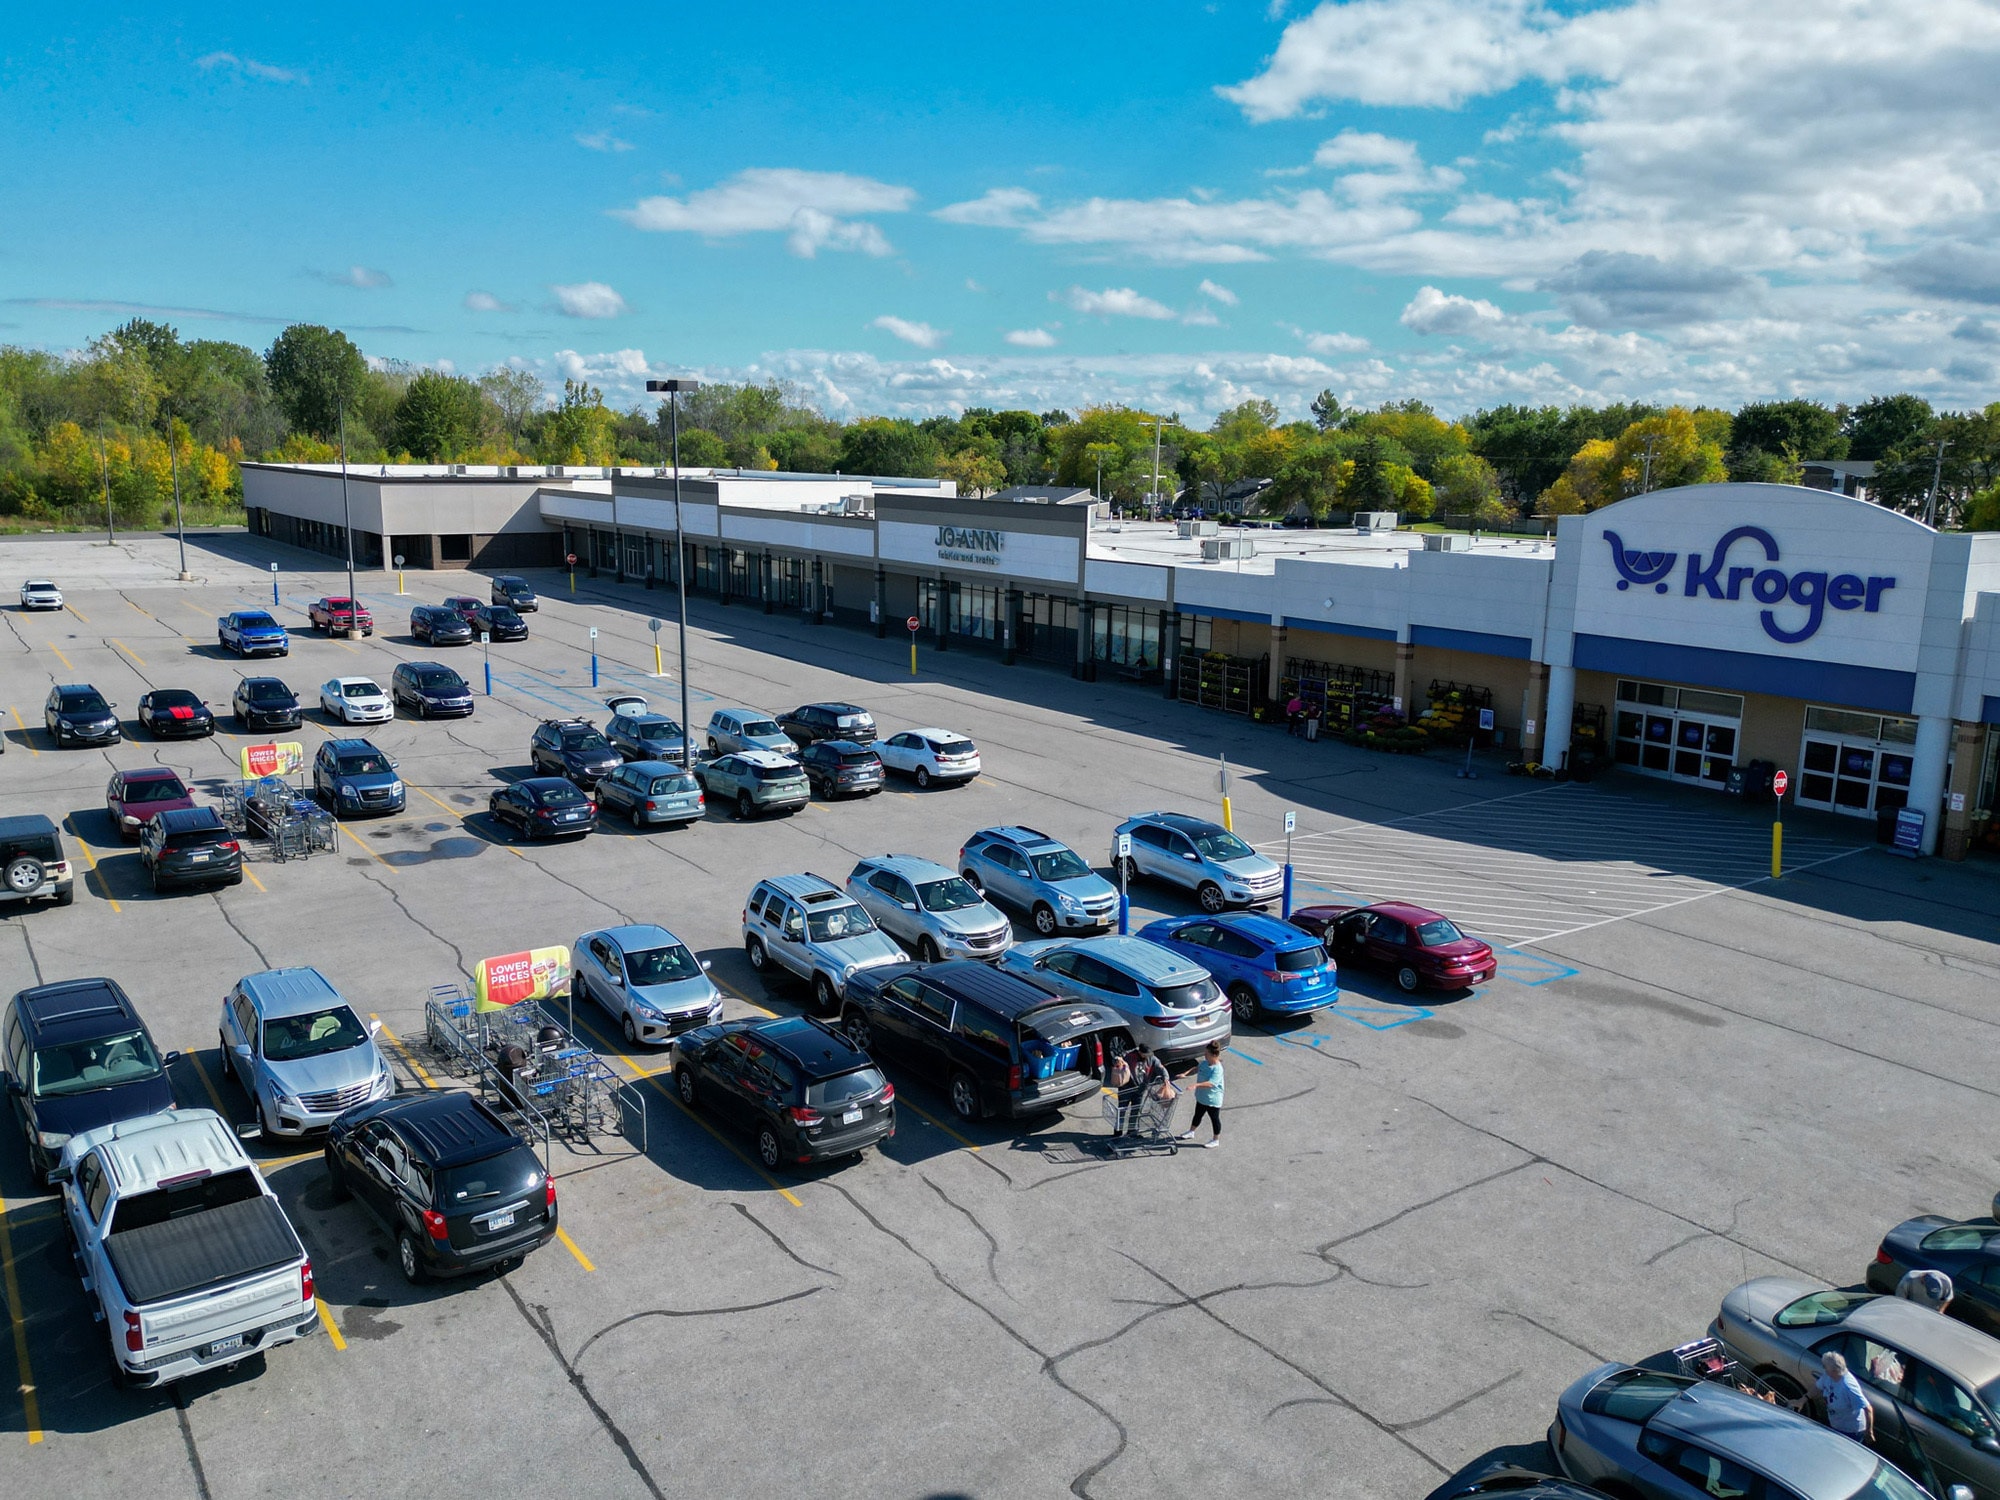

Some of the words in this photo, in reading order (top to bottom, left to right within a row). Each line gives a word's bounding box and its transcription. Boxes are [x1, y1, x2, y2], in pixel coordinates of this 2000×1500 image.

[1684, 525, 1896, 643] Kroger
[1774, 778, 1787, 788] STOP
[490, 961, 529, 975] LOWER
[491, 970, 530, 985] PRICES
